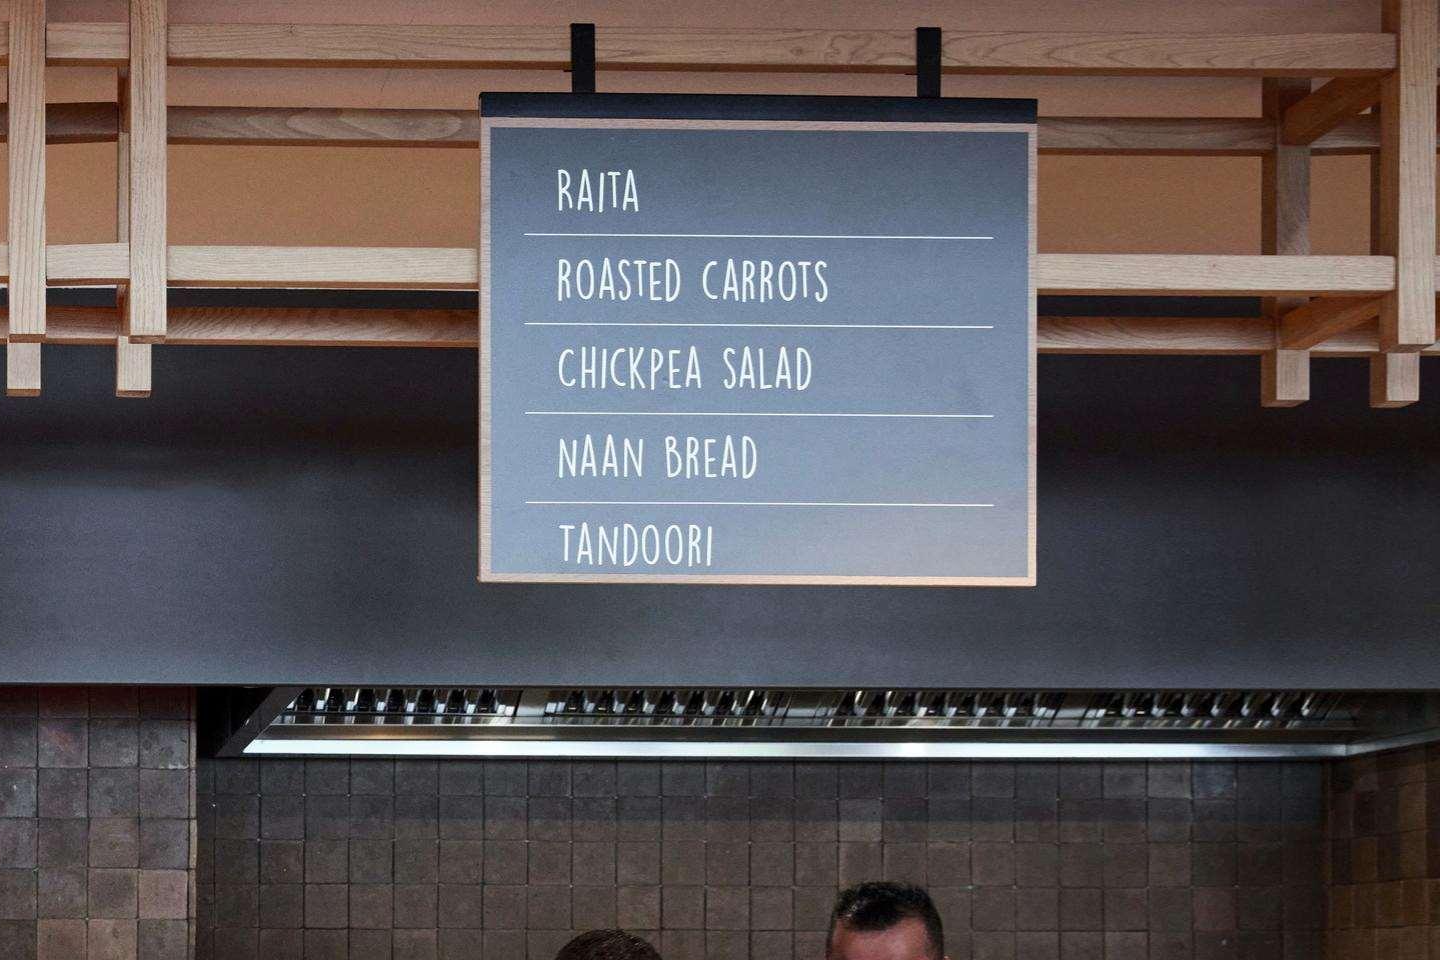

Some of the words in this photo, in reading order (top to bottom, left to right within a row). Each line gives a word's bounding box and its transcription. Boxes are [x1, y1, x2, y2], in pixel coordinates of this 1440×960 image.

[558, 168, 639, 213] RAITA
[558, 258, 681, 303] ROASTED
[702, 258, 829, 303] CARROTS
[558, 345, 702, 391] CHICKPEA
[723, 345, 812, 391] SALAD
[558, 434, 644, 479] NAAN
[665, 434, 758, 479] BREAD
[558, 522, 713, 567] TANDOORI
